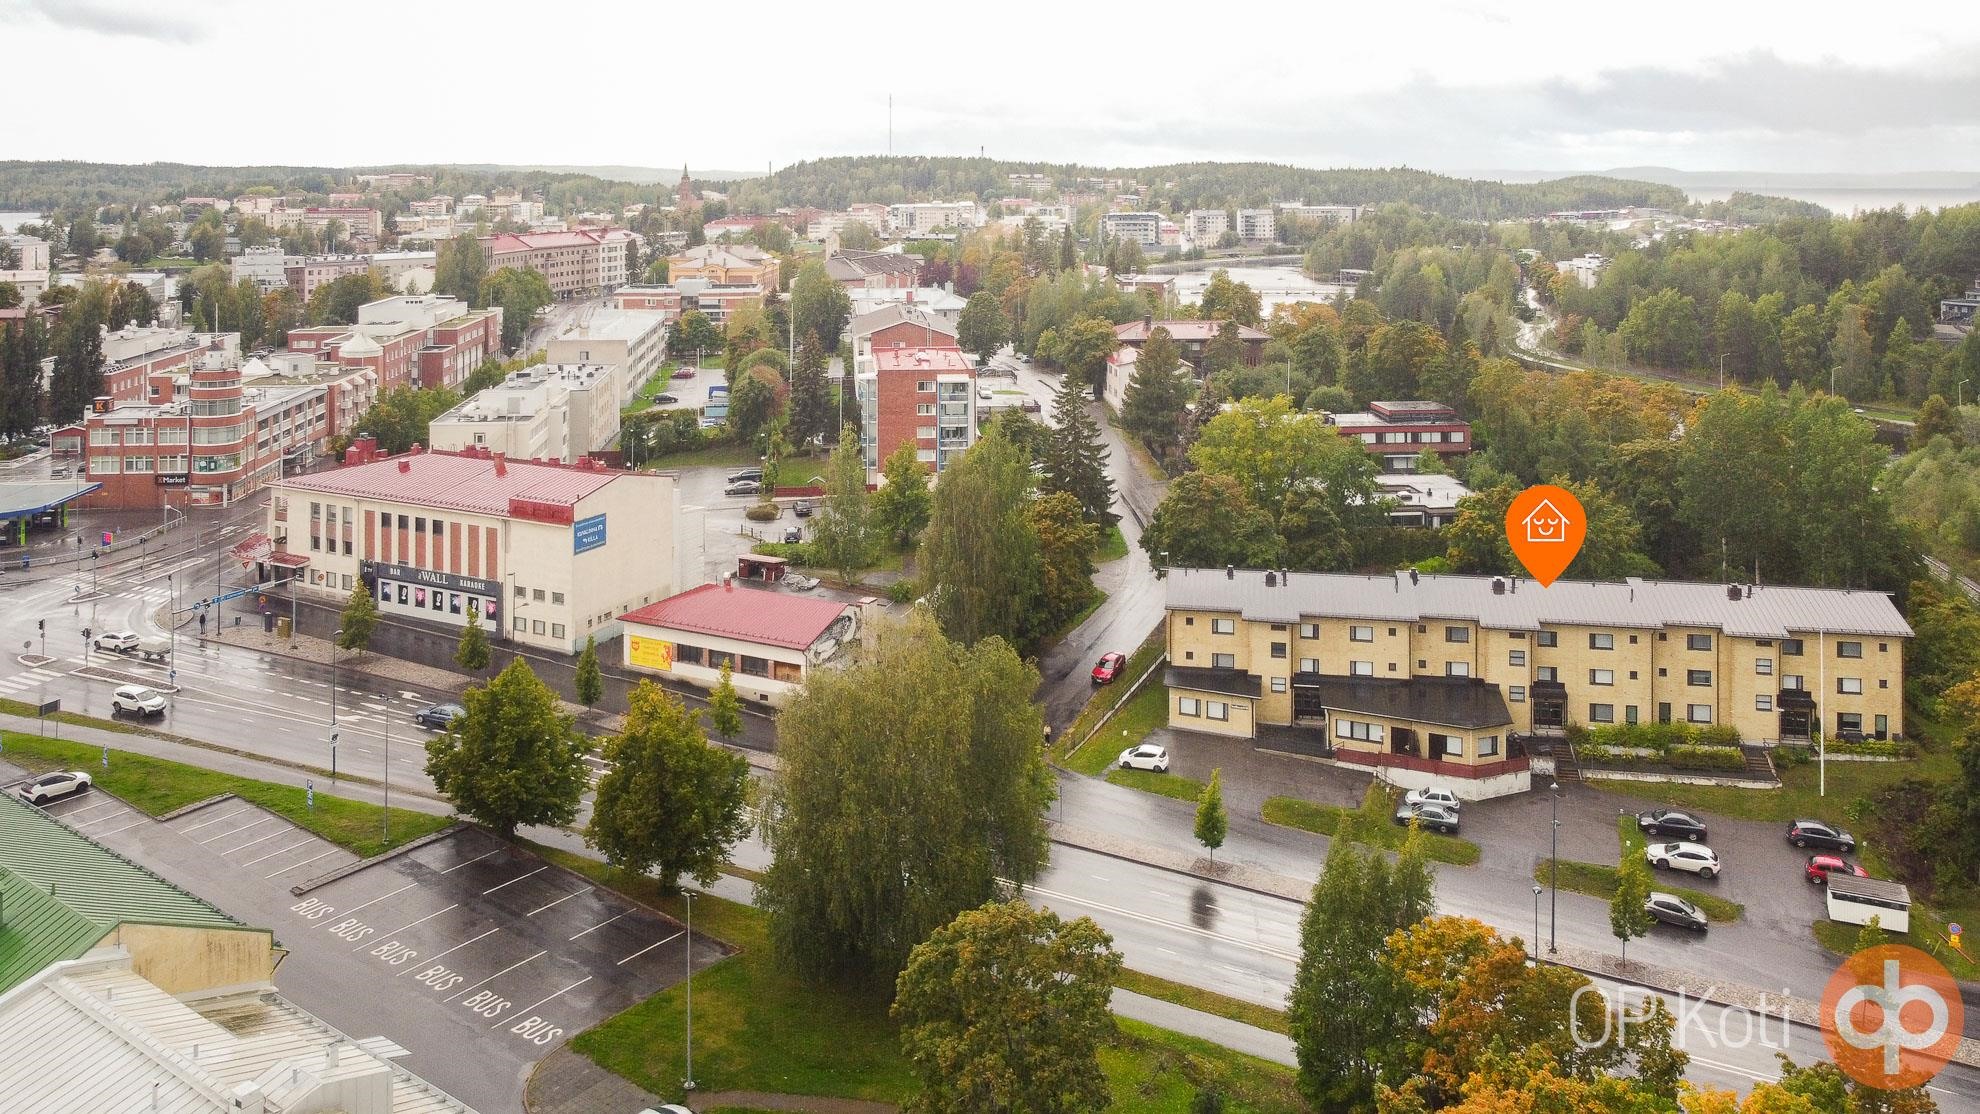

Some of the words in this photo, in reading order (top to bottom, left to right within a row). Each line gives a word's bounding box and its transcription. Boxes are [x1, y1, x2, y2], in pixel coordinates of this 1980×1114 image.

[390, 567, 401, 576] BAR
[421, 571, 449, 585] WALL
[290, 897, 335, 920] BUS
[328, 918, 374, 942] BUS
[370, 941, 417, 965] BUS
[415, 965, 463, 991] BUS
[462, 990, 512, 1018] BUS
[510, 1016, 564, 1046] BUS
